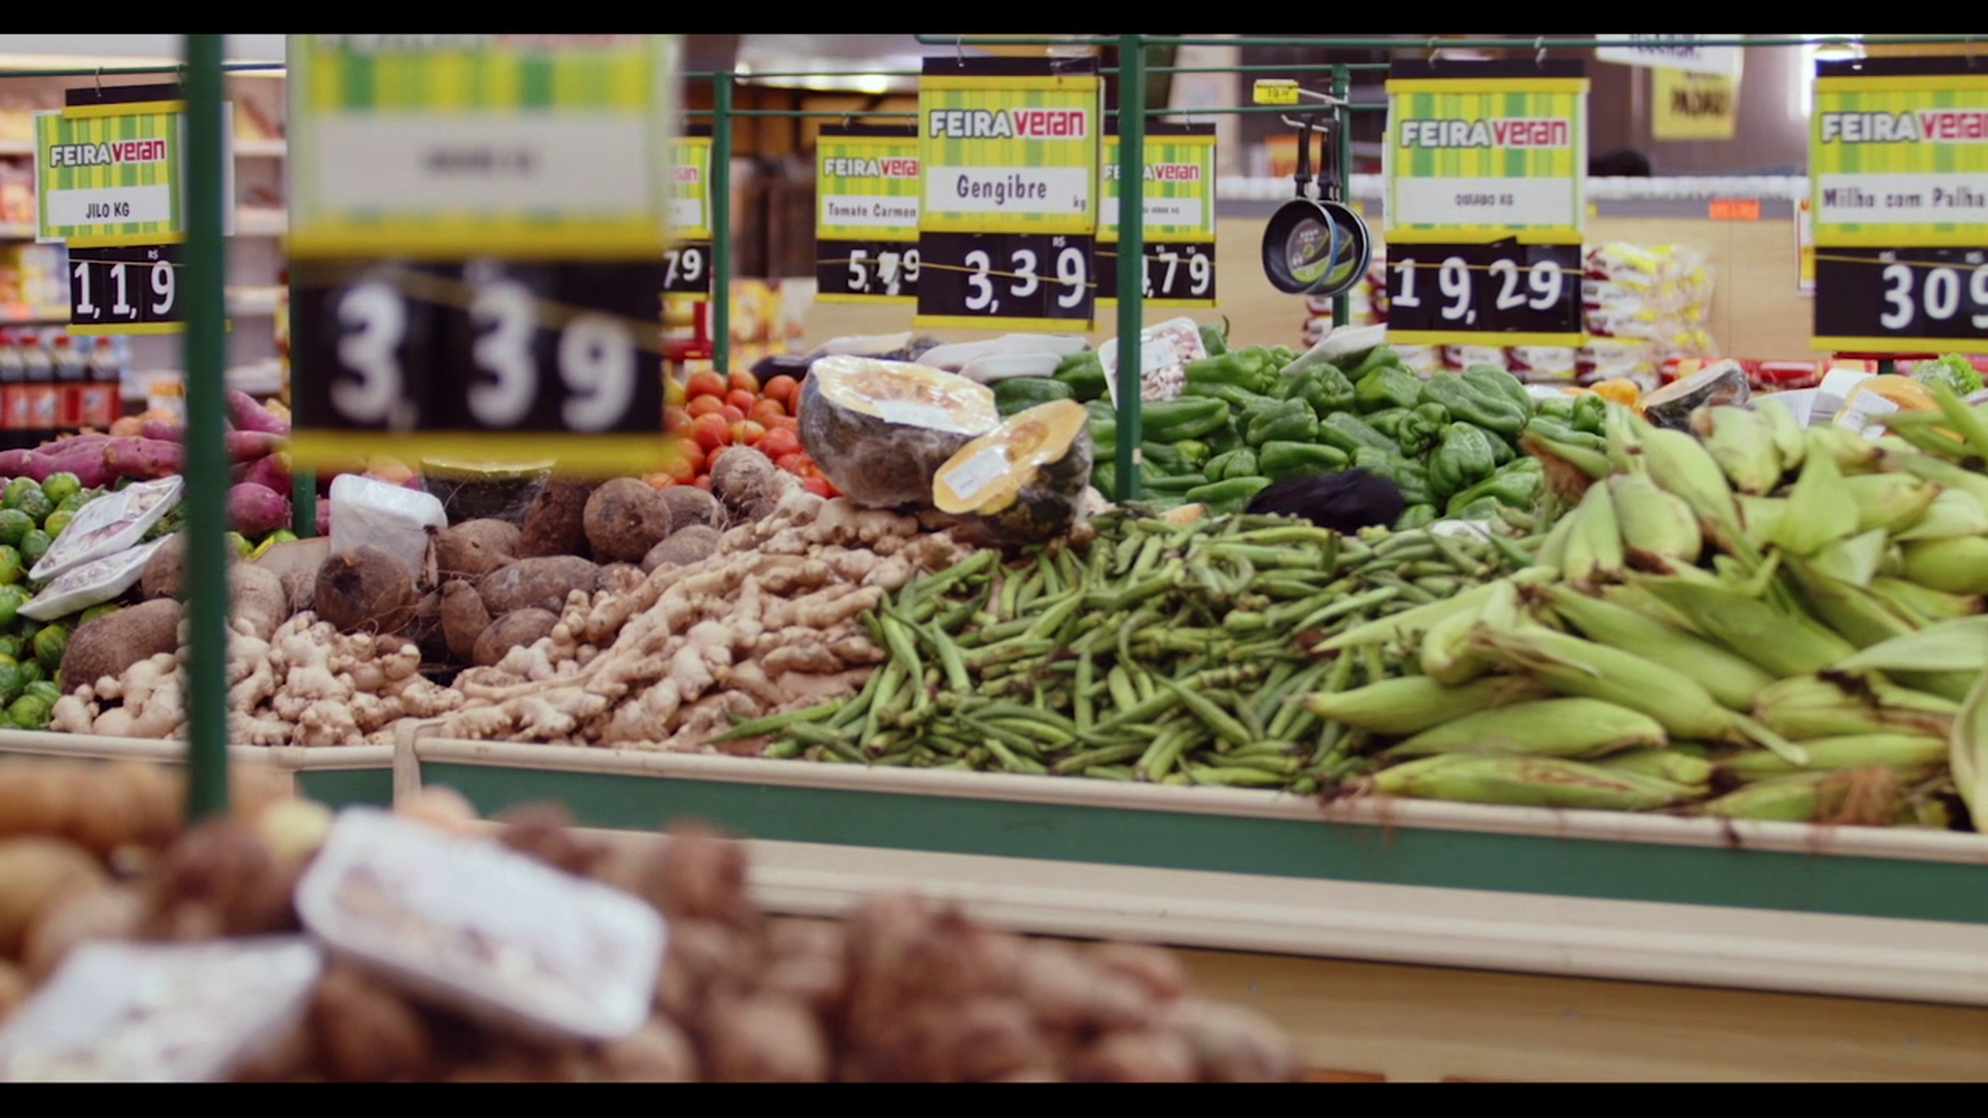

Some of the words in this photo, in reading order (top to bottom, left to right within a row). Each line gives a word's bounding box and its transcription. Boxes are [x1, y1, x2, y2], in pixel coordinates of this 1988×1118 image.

[956, 174, 1047, 205] Gengibre
[1823, 187, 1874, 209] Milho
[1885, 192, 1921, 208] com
[1933, 187, 1985, 209] Palha
[85, 203, 110, 218] JILO
[114, 202, 130, 217] KG
[828, 203, 868, 217] Tomate
[873, 204, 917, 218] Carmen
[1073, 195, 1086, 211] kg
[965, 247, 1087, 314] 3,39
